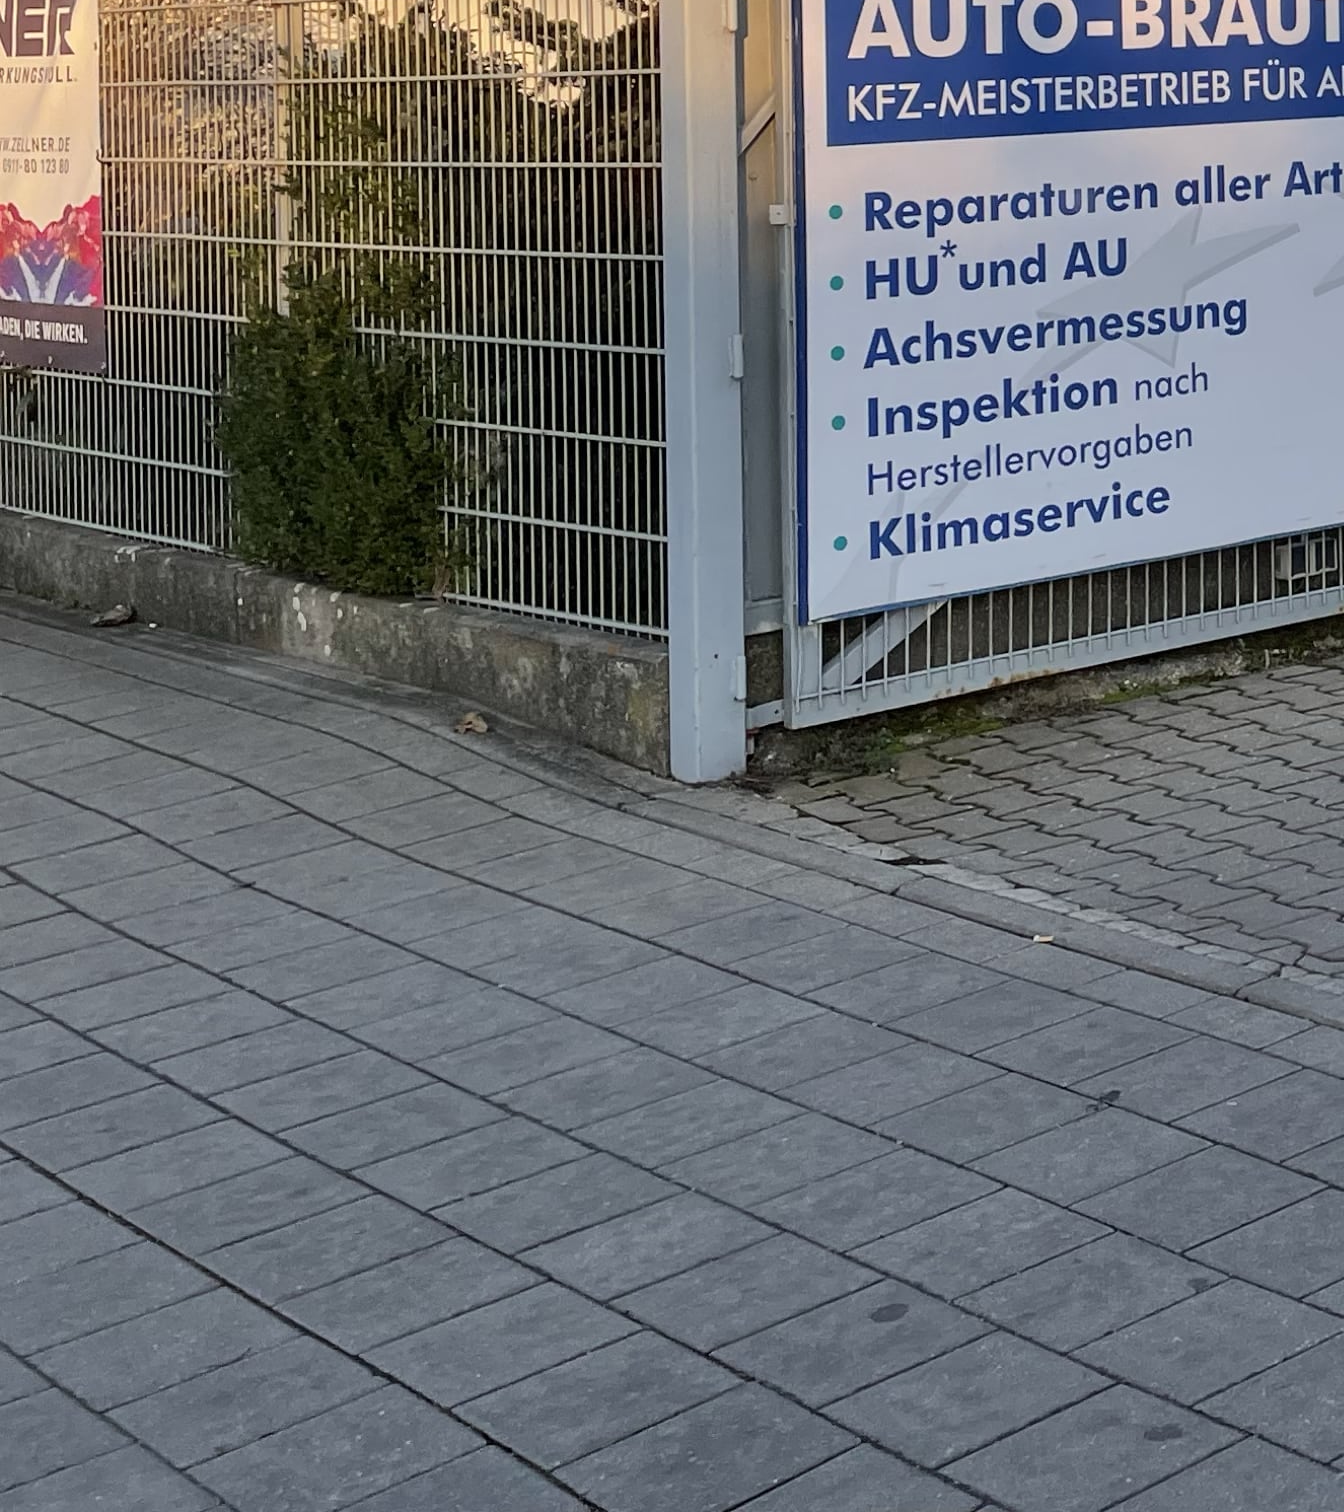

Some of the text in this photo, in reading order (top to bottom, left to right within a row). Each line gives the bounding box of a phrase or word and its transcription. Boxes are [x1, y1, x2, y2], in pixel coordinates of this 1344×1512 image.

[846, 68, 1232, 123] KFZ-MEISTERBETRIEB
[1243, 58, 1306, 103] FÜR
[864, 160, 1343, 237] Reparaturen aller Art
[958, 243, 1047, 291] und
[1063, 237, 1128, 280] AU
[24, 319, 41, 339] DIE
[41, 321, 88, 344] WIRKEN.
[863, 298, 1248, 369] Achsvermessung
[866, 362, 1209, 438] Inspektion nach
[866, 423, 1194, 496] Herstellervorgaben
[868, 481, 1171, 560] Klimaservice
